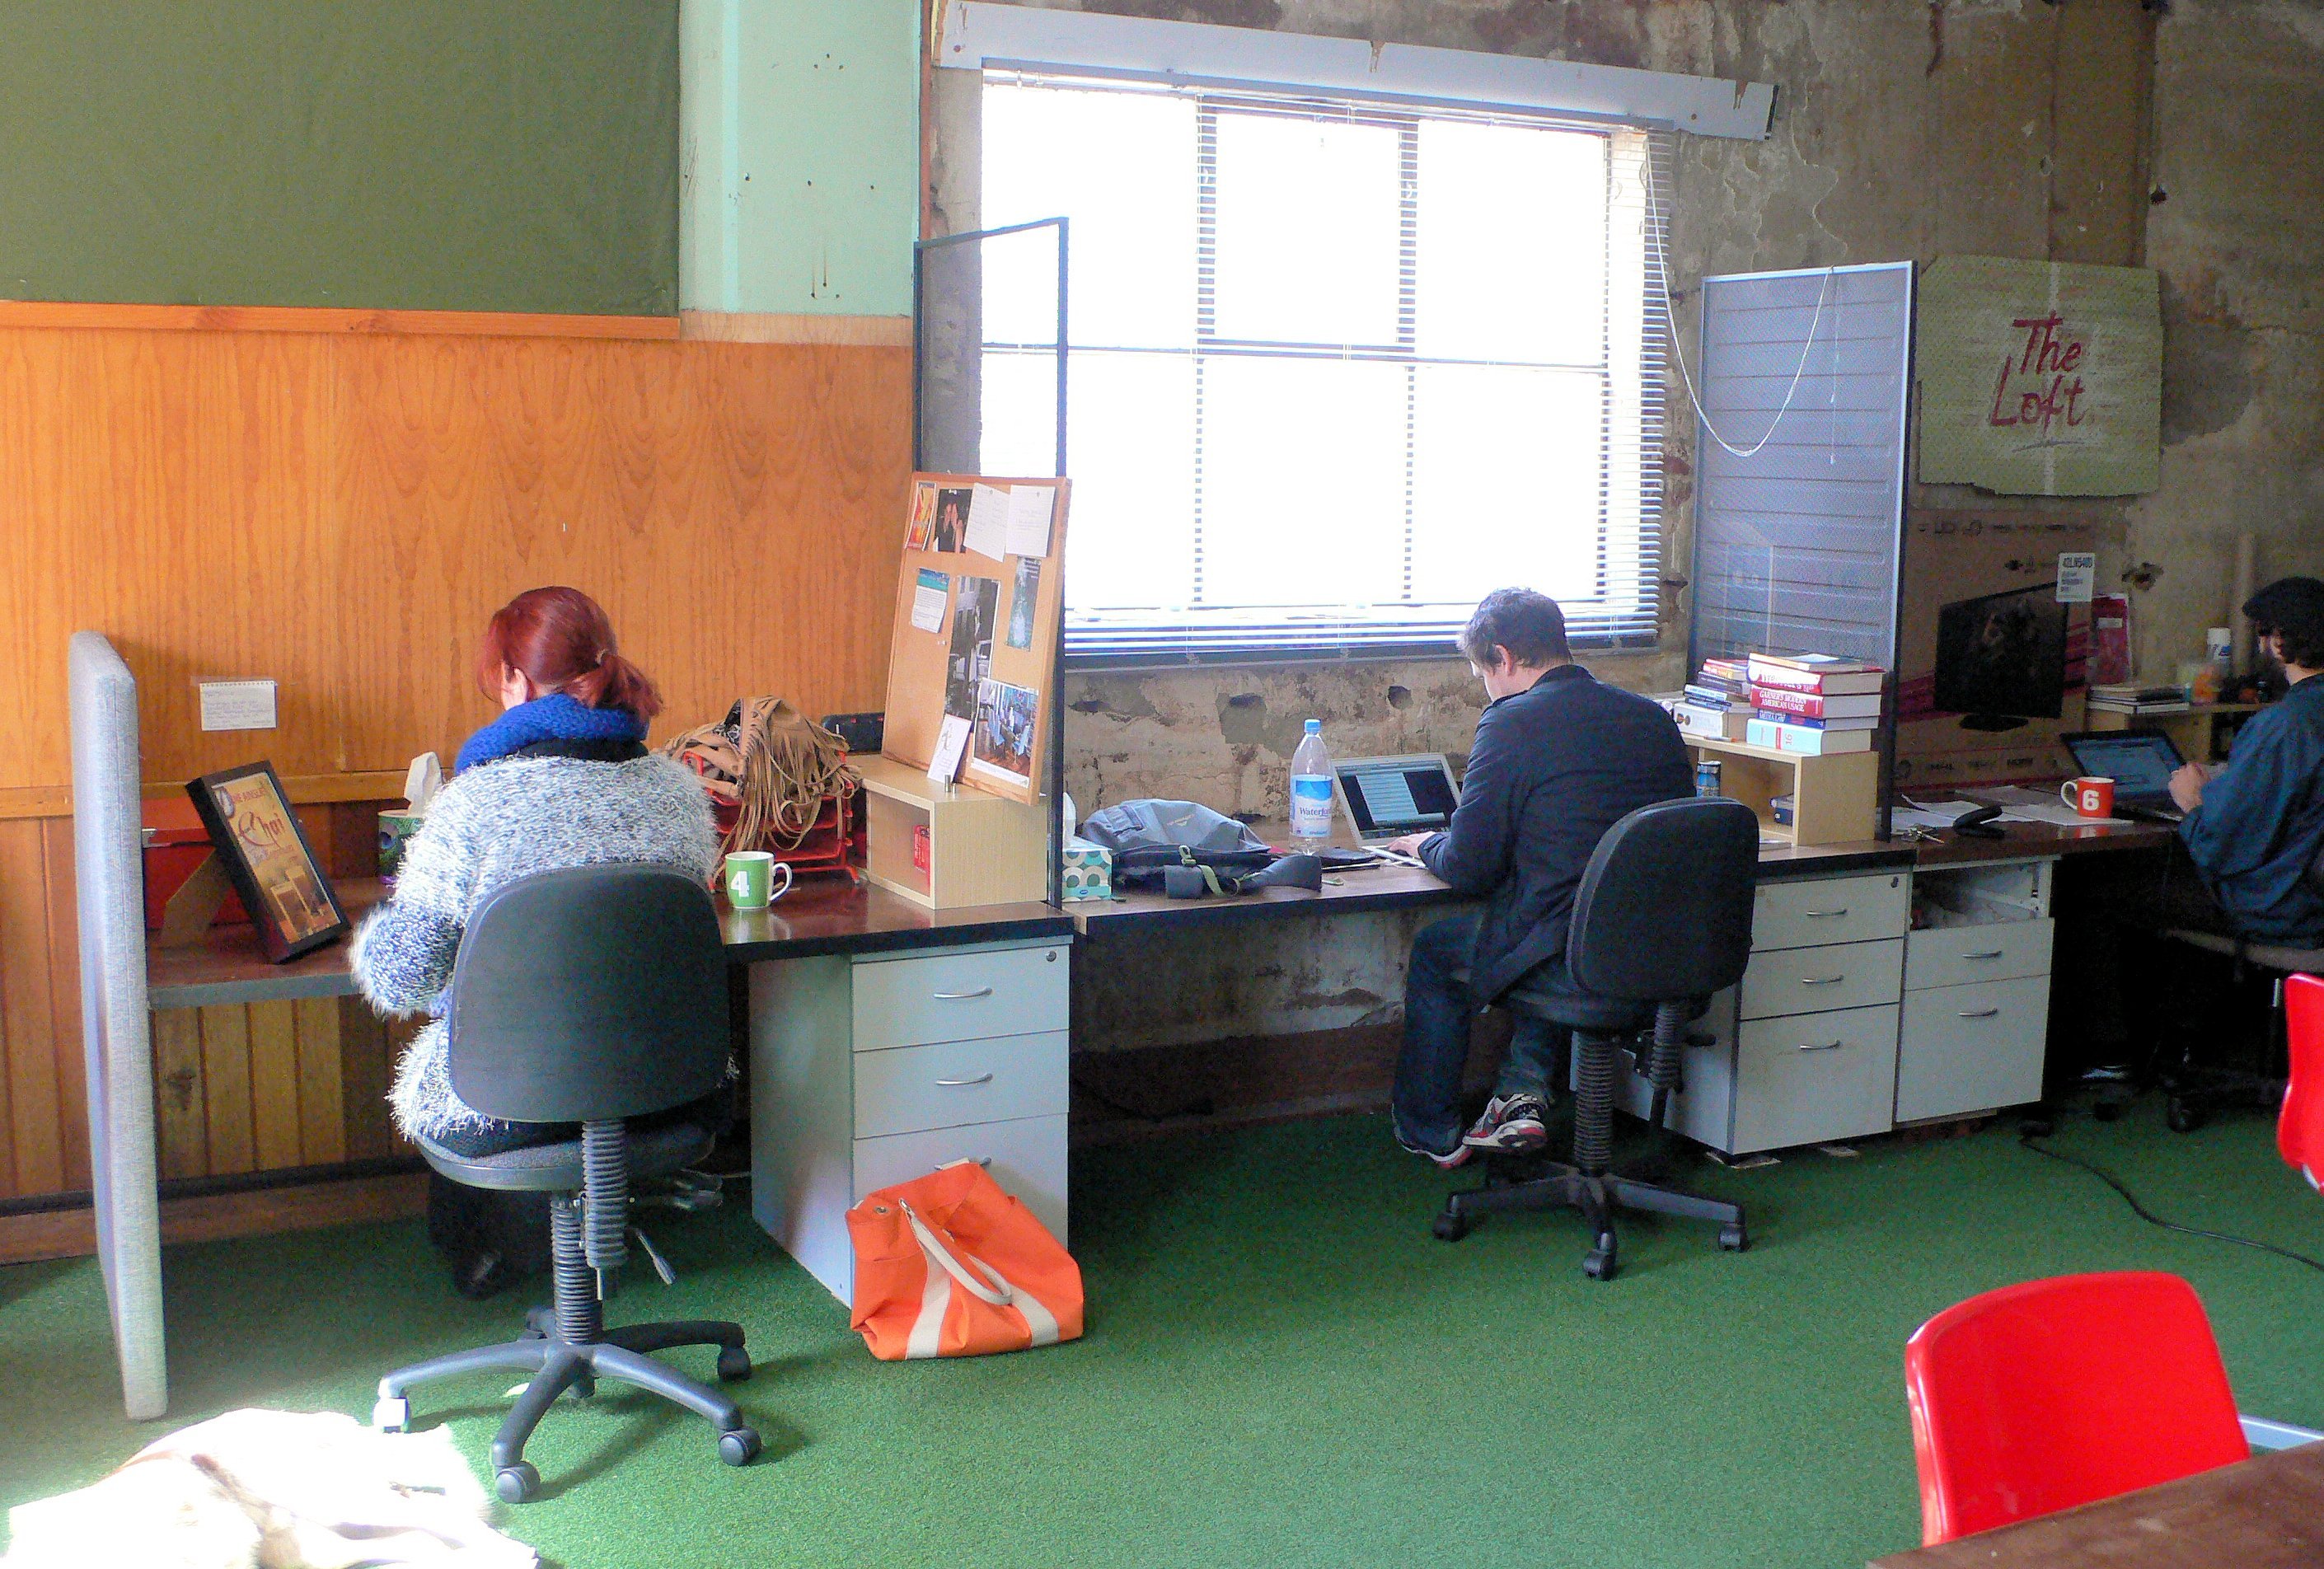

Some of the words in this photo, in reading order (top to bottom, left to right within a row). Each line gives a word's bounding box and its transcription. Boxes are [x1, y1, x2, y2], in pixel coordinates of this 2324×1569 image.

[2012, 310, 2083, 374] The
[1989, 355, 2087, 437] Loft
[2081, 789, 2100, 811] 6
[730, 870, 750, 897] 4
